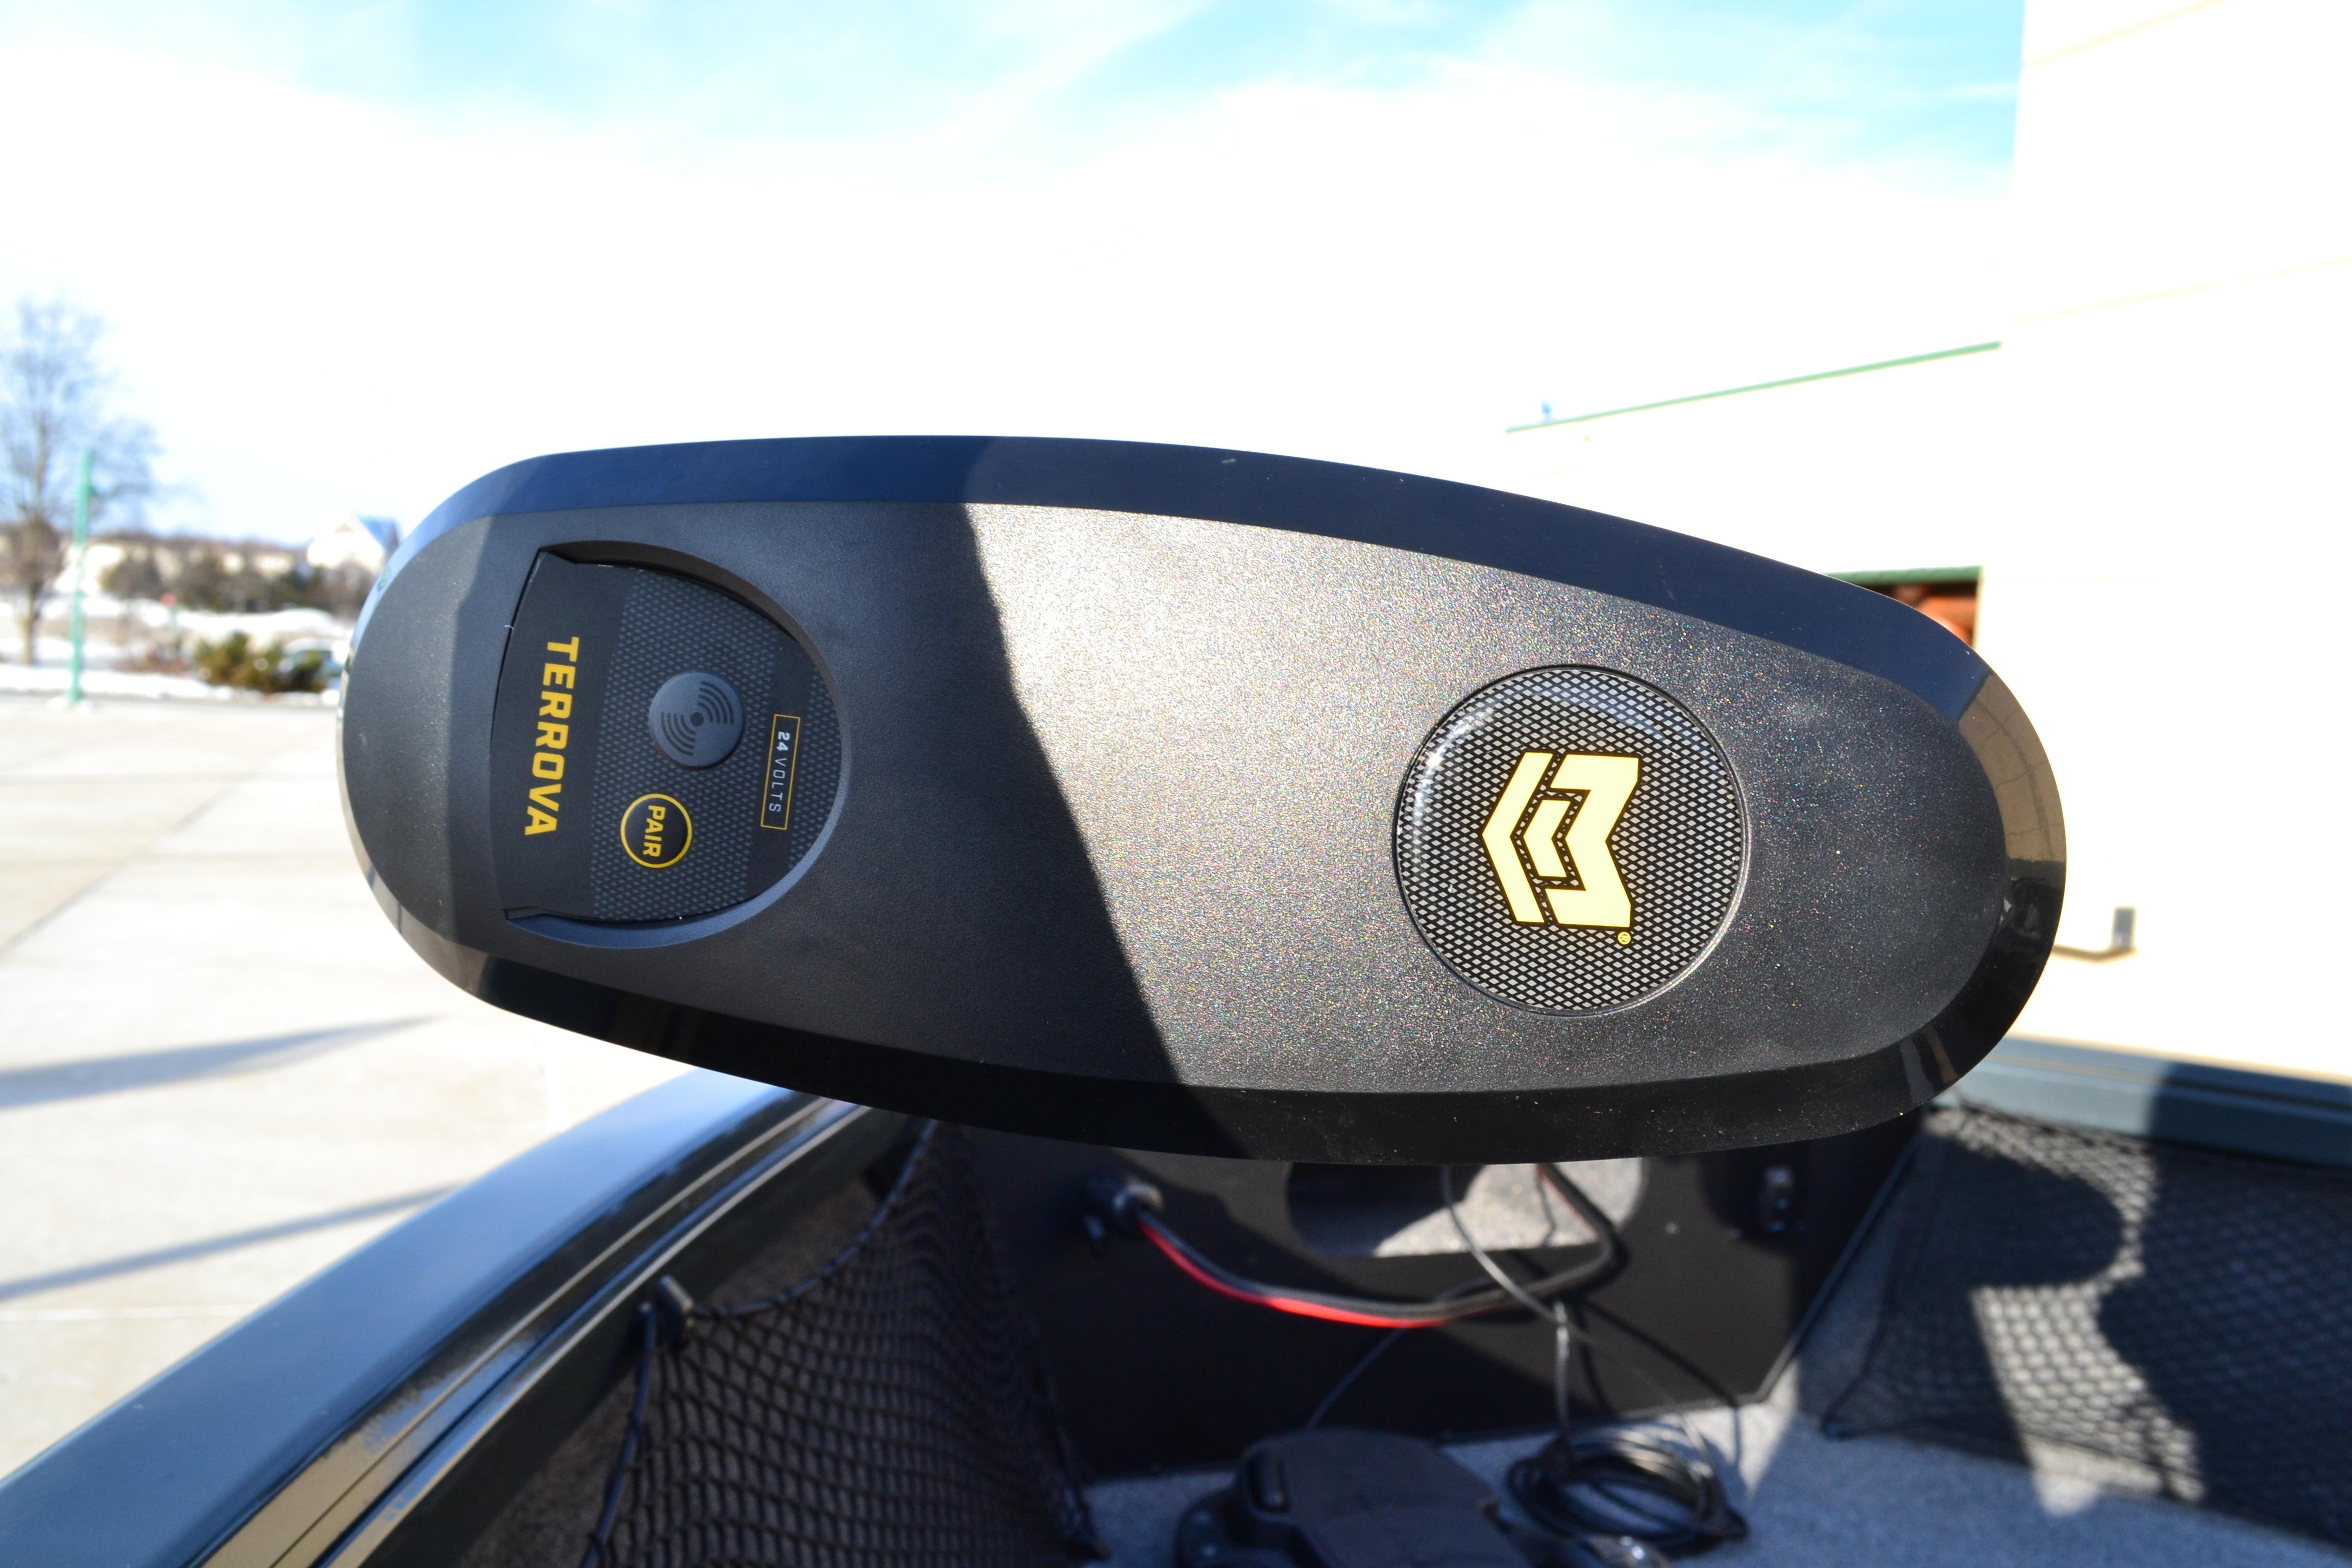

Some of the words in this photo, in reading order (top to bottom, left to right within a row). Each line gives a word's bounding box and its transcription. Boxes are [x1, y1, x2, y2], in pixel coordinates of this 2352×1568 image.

[524, 636, 580, 836] TERROVA
[776, 731, 791, 751] 24
[769, 757, 787, 812] VOLTS
[643, 804, 666, 857] PAIR
